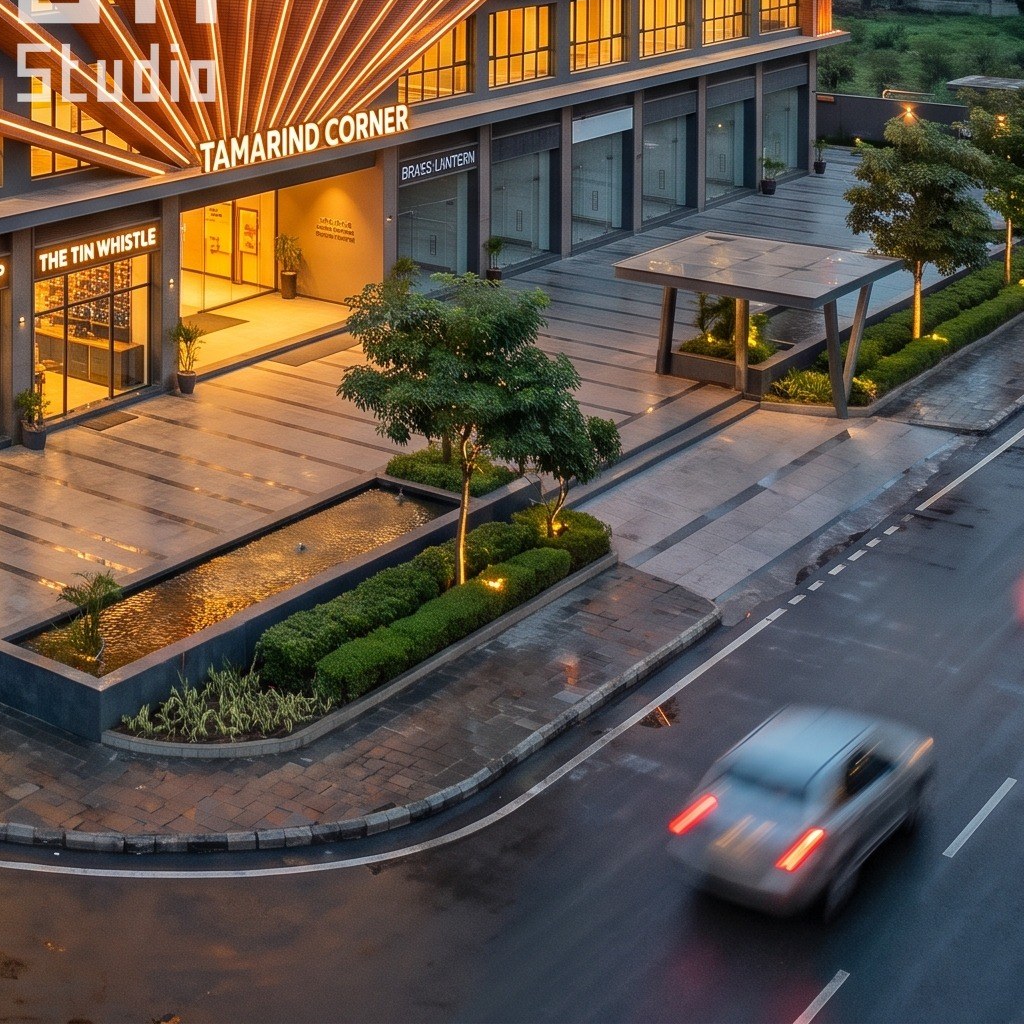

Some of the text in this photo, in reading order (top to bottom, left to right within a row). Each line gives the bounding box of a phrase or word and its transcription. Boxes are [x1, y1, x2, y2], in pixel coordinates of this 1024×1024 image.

[199, 104, 409, 173] TAMARIND CORNER
[434, 150, 475, 172] LANTERN
[39, 227, 157, 272] THE TIN WHISTLE
